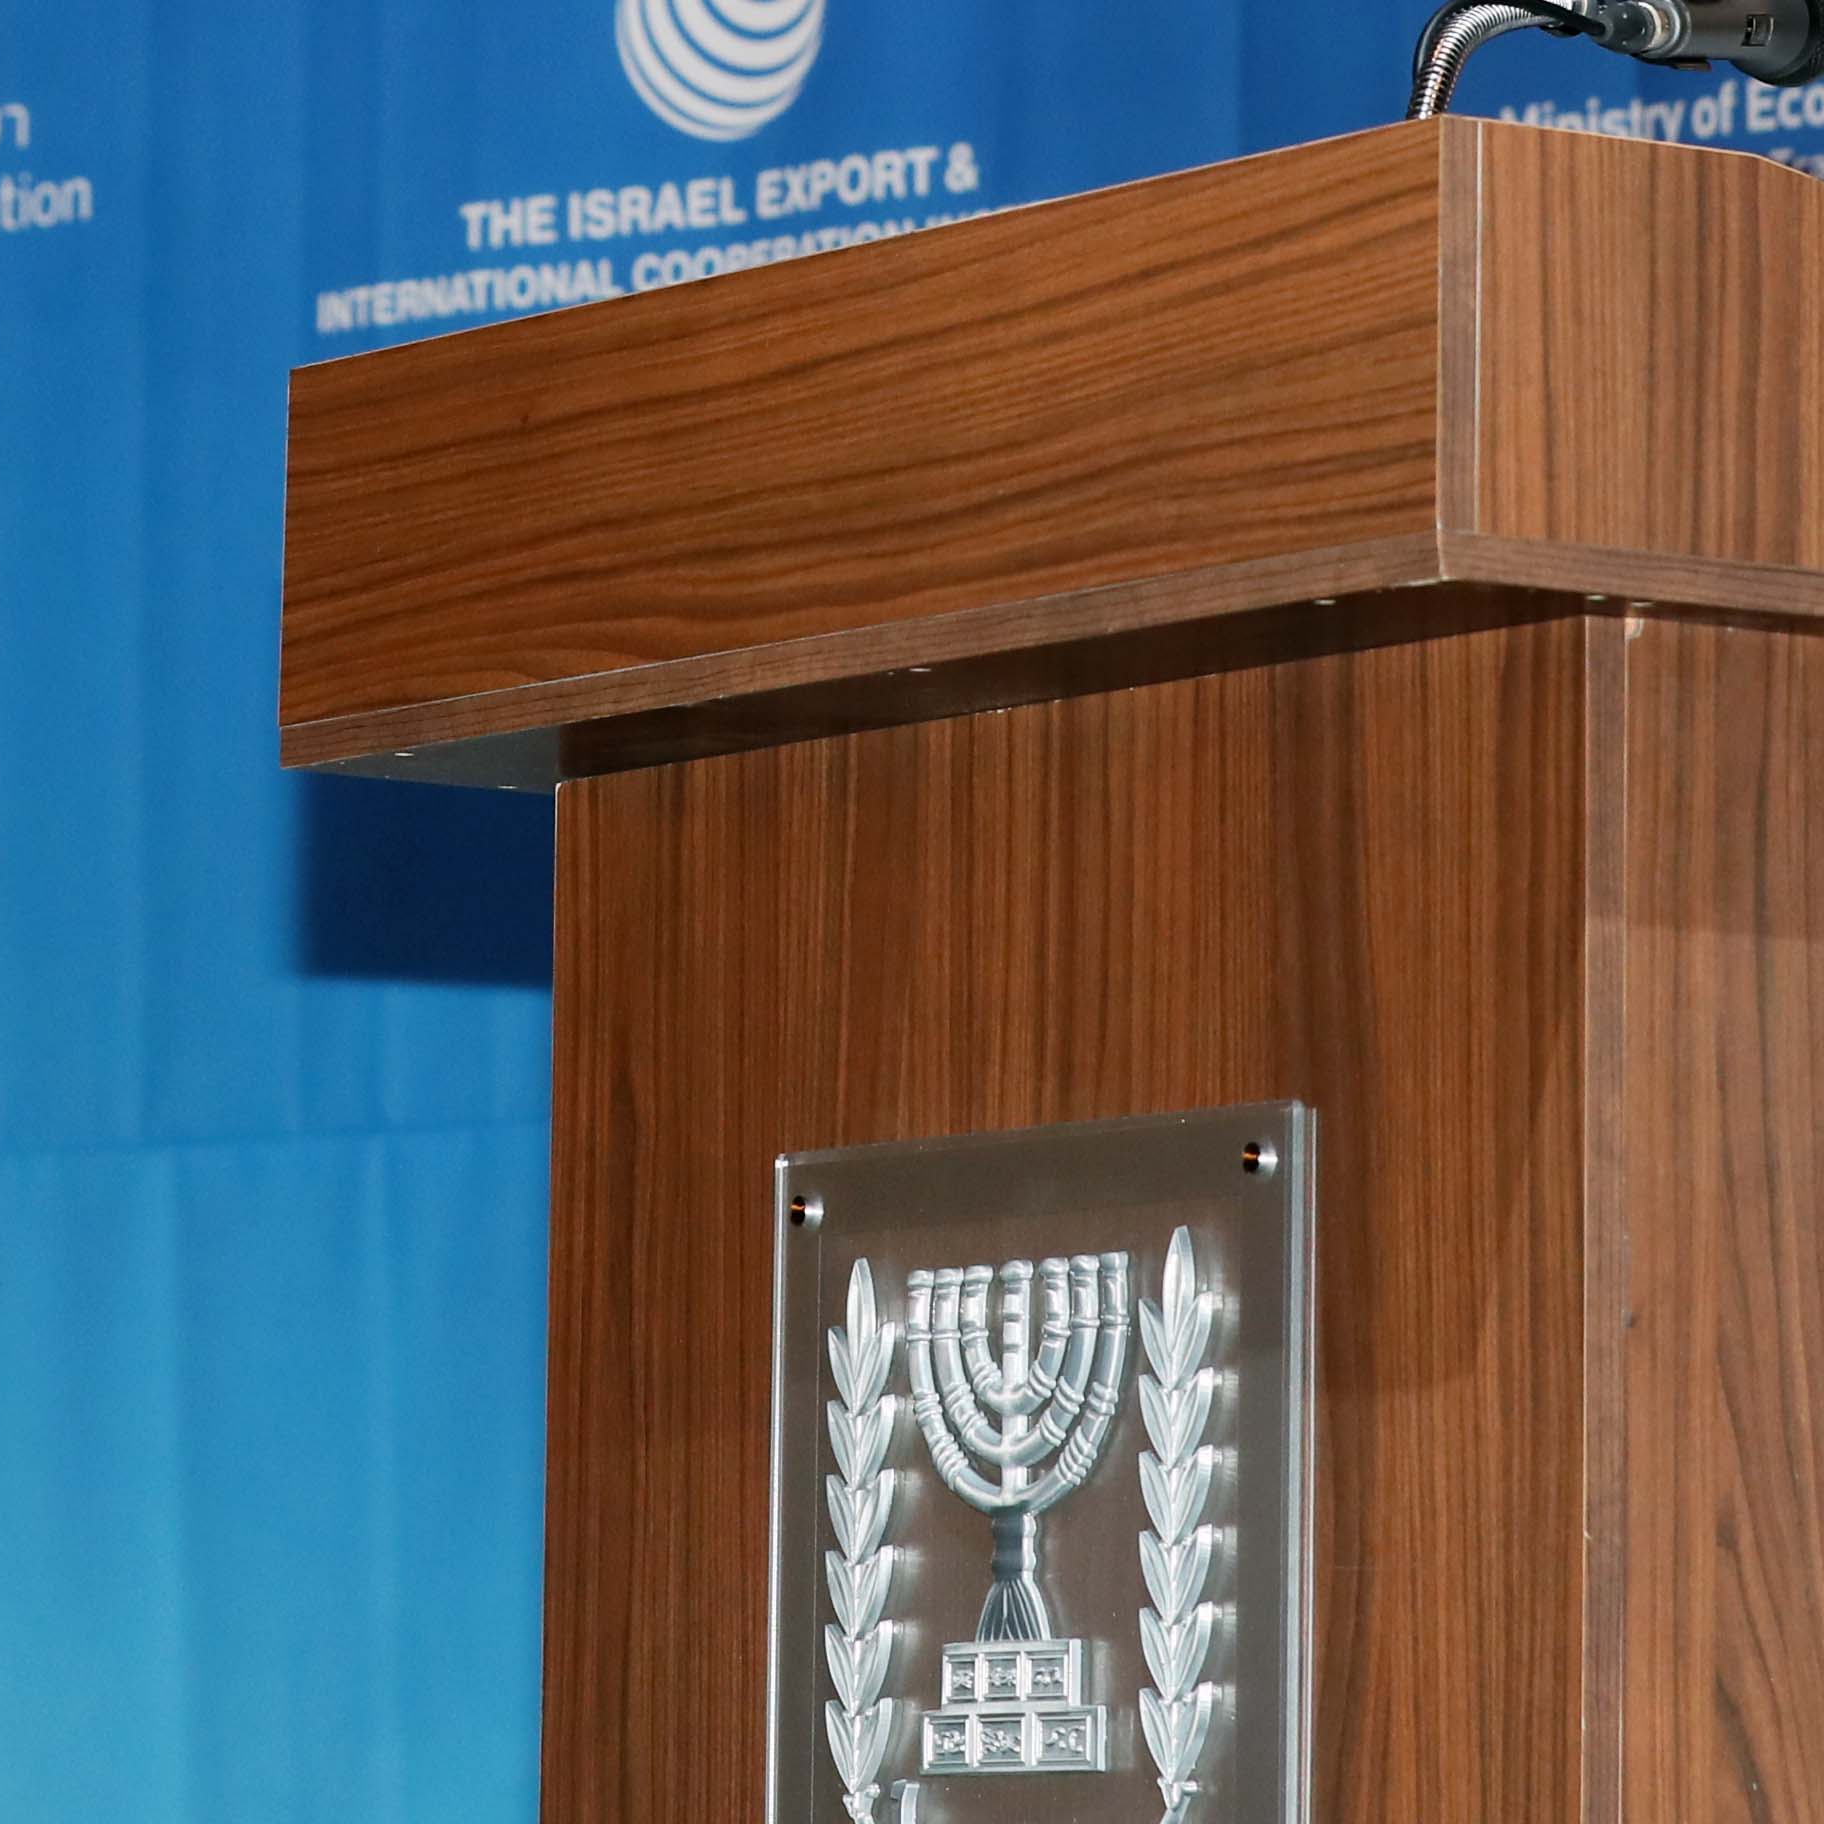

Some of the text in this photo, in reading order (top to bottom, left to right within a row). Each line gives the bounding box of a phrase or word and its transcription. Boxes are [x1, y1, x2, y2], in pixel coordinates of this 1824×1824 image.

[1692, 79, 1737, 139] of
[459, 194, 559, 250] THE
[567, 177, 747, 242] ISRAEL
[756, 145, 940, 220] EXPORT
[943, 141, 980, 194] &
[316, 258, 625, 334] INTERNATIONAL
